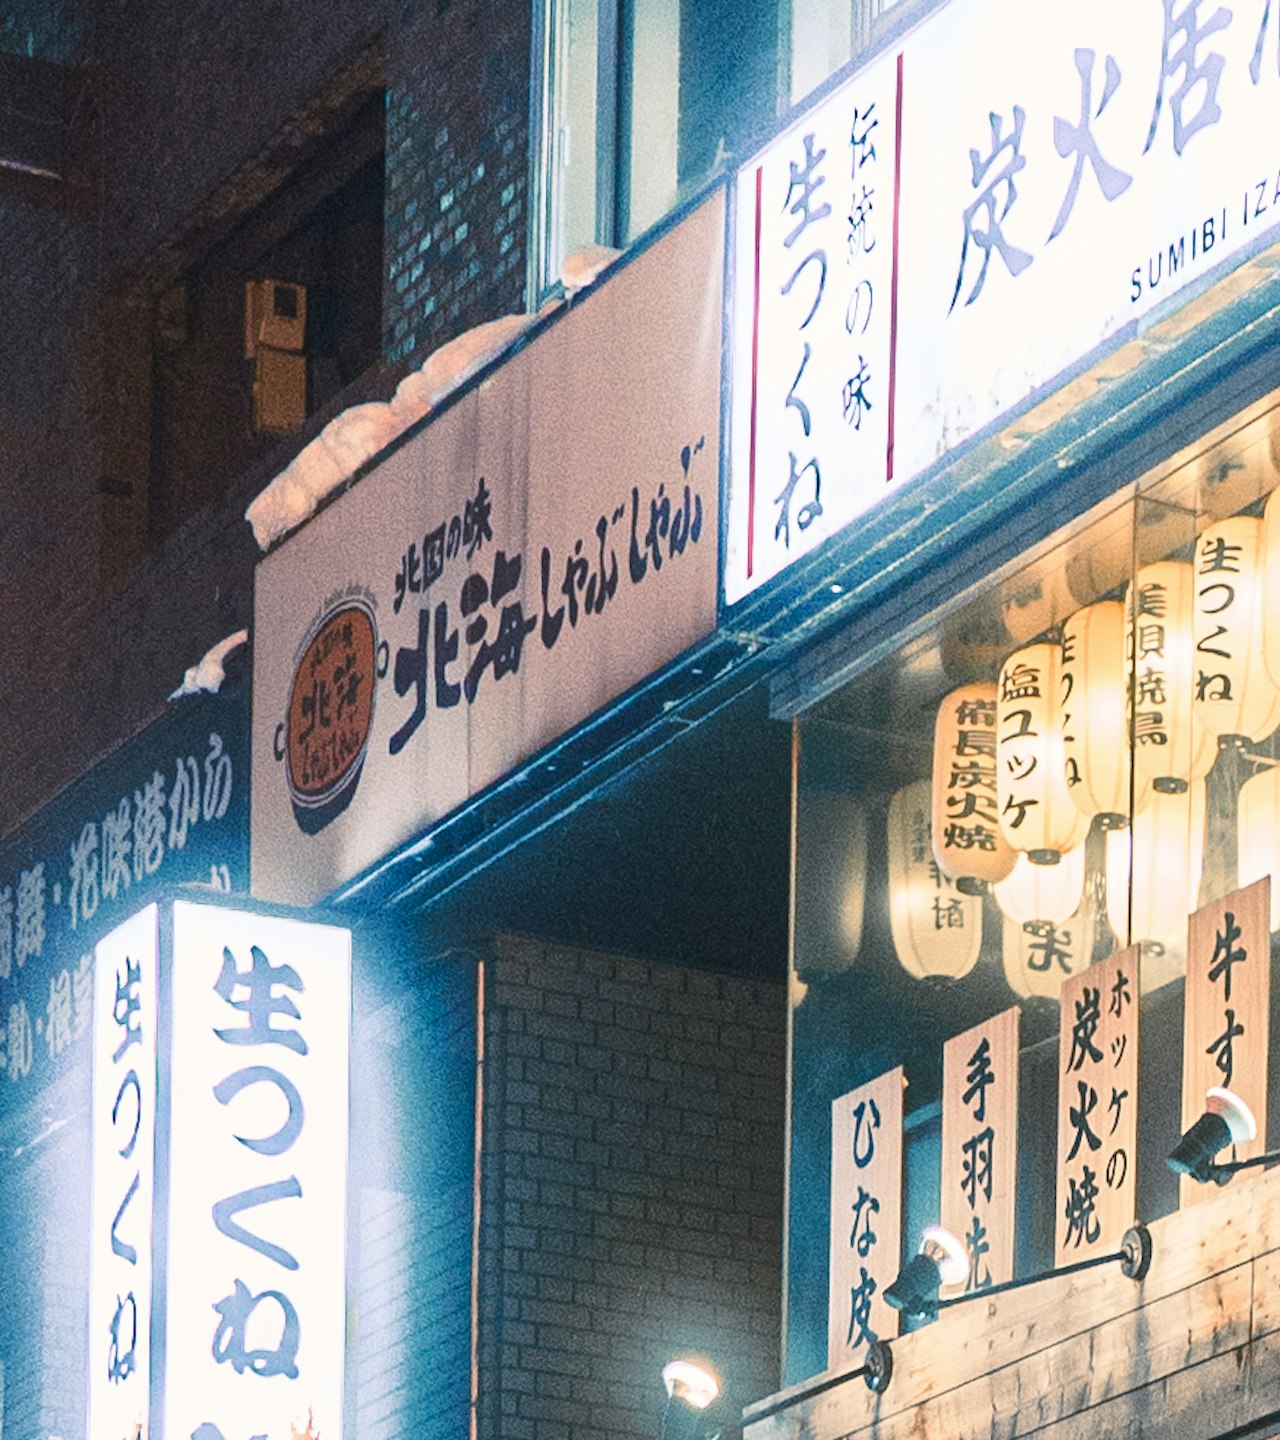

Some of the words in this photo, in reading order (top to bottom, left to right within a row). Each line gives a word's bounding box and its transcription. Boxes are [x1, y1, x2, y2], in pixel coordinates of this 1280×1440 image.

[773, 135, 832, 547] 生つくね
[843, 104, 879, 431] 伝統の味
[1130, 212, 1228, 303] SUMIBI
[389, 436, 705, 754] 北海しゃぶしゃぶ
[394, 478, 494, 608] 北国の味
[1195, 536, 1244, 704] 生つくね
[1000, 662, 1041, 829] 塩ユッケ
[213, 945, 309, 1379] 生つくね
[1063, 987, 1103, 1251] 炭火焼
[1107, 970, 1132, 1188] ホッケの
[846, 1099, 881, 1349] ひな皮
